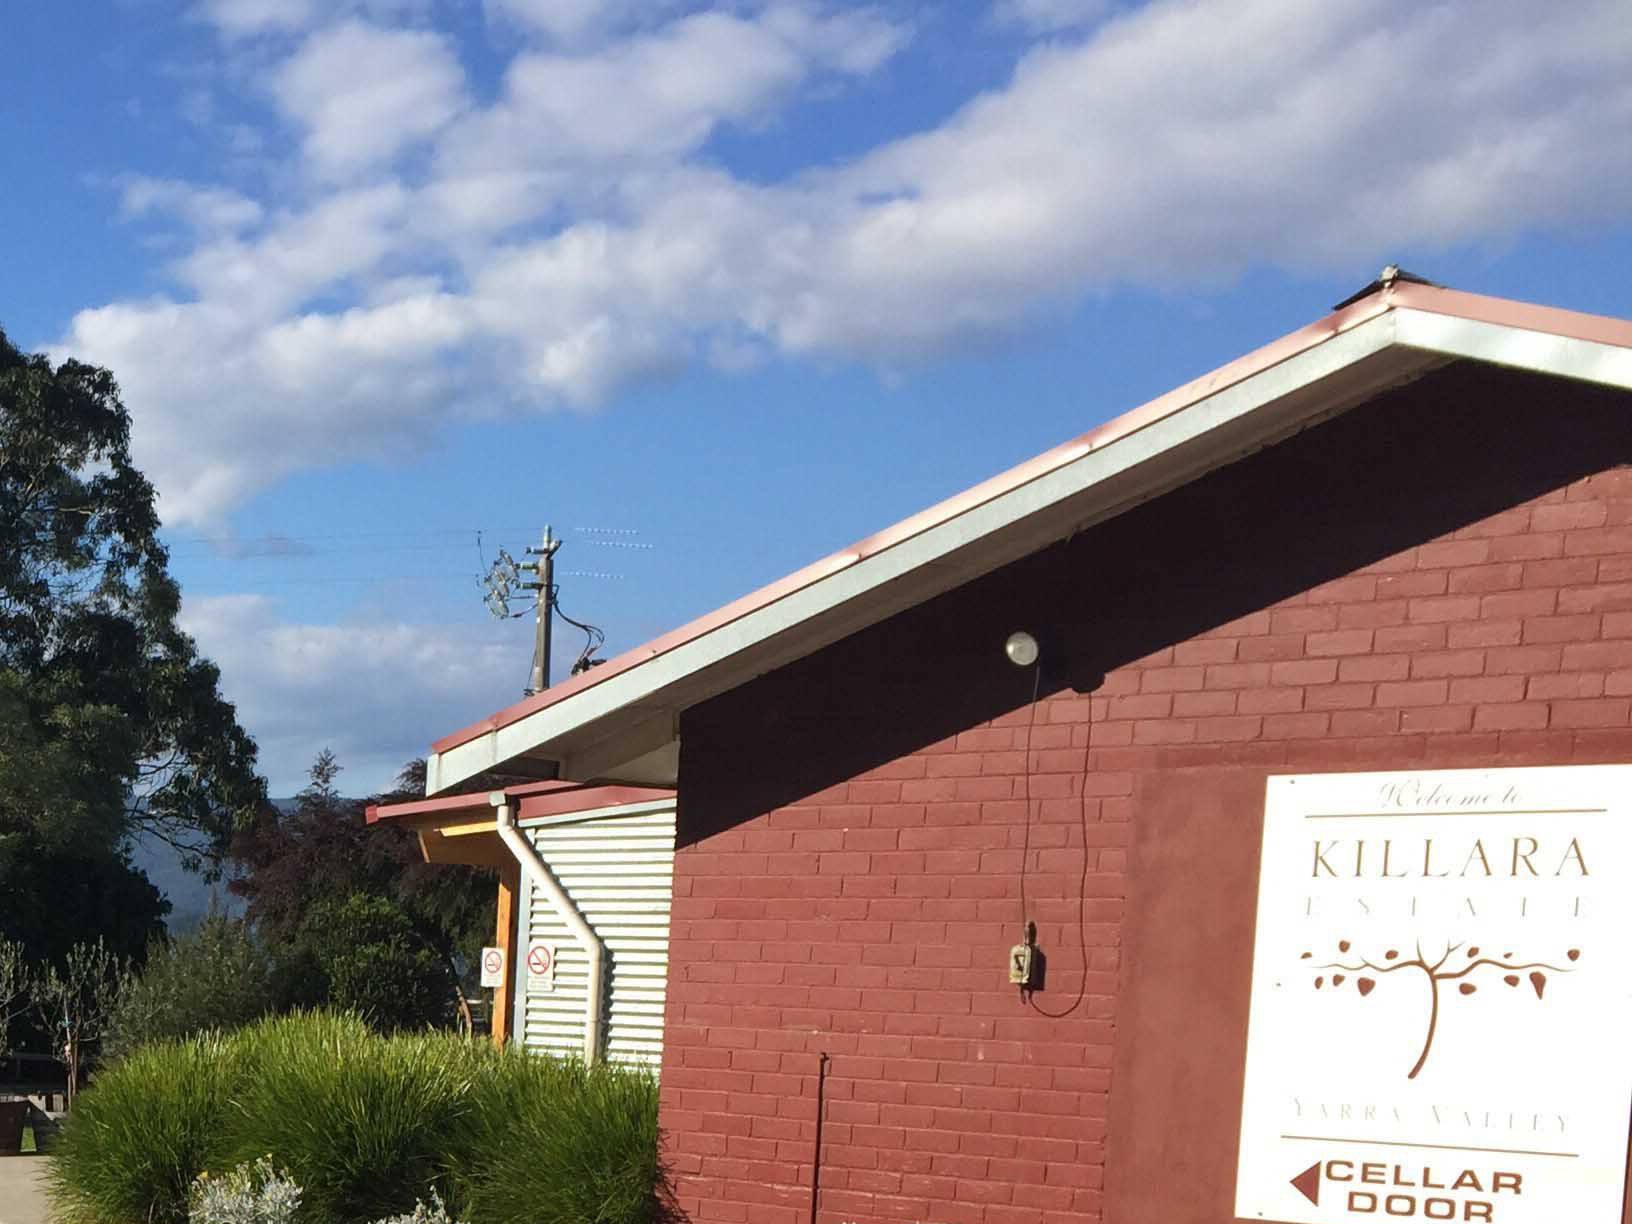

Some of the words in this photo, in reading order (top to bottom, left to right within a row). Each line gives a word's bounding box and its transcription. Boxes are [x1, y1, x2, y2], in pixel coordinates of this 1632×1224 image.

[1311, 836, 1590, 878] KILLARA
[1324, 1159, 1524, 1195] CELLAR
[1346, 1191, 1494, 1224] DOOR
